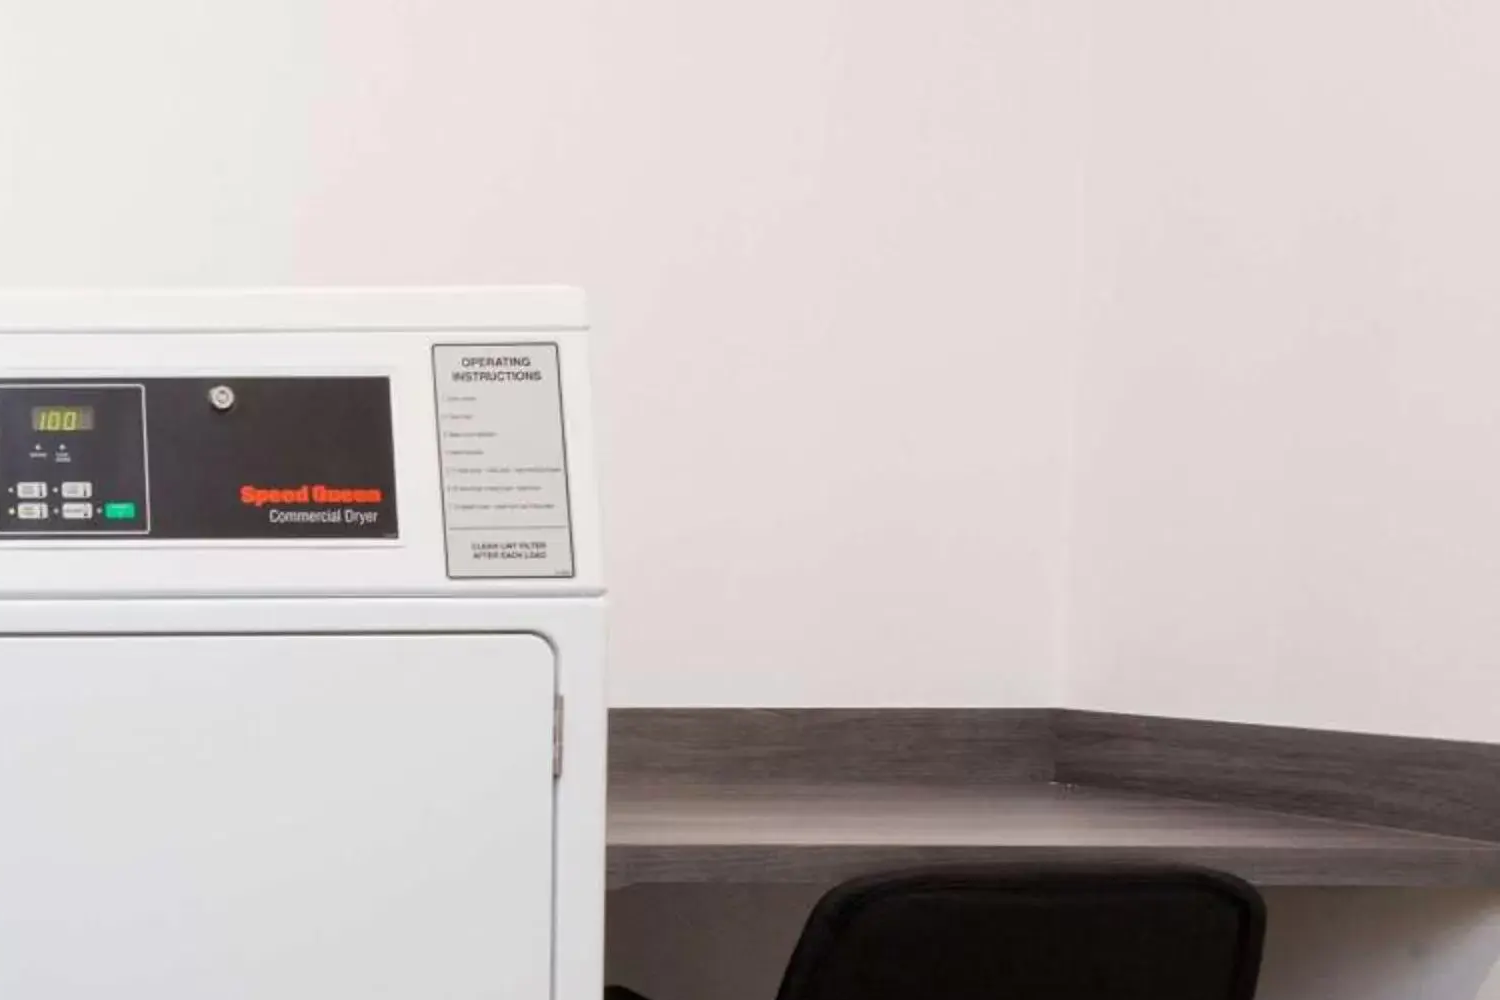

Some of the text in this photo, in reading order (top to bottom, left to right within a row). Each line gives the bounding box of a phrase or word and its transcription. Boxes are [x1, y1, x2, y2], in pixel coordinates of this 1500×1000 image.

[461, 357, 531, 368] OPERATING
[451, 371, 543, 382] INSTRUCTIONS
[240, 484, 382, 506] Speed Queen
[269, 508, 378, 525] Commercial Dryer
